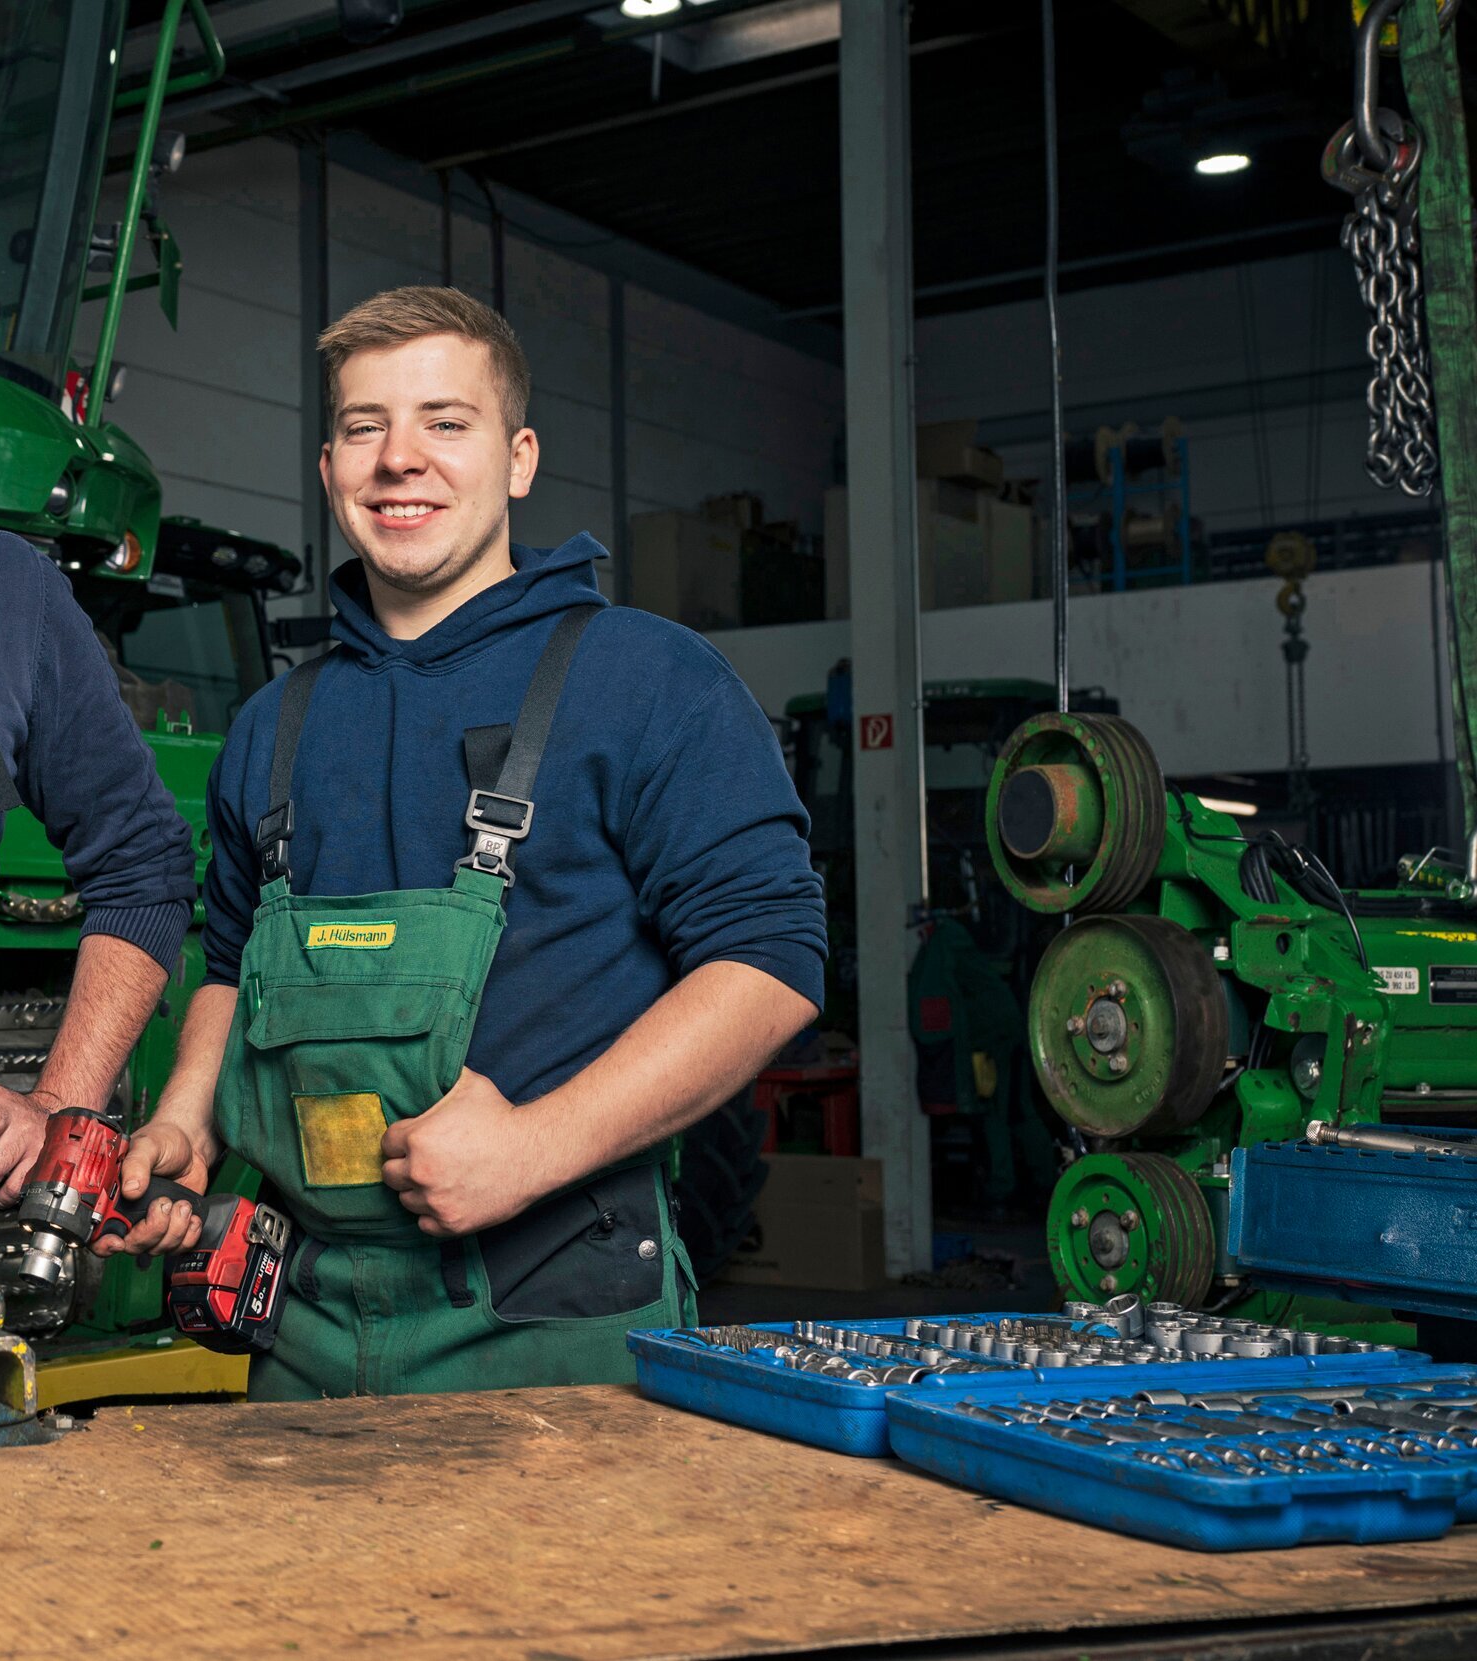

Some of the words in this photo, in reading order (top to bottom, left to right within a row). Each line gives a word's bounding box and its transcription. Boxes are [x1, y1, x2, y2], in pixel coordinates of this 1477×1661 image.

[317, 929, 326, 942] J.
[329, 928, 387, 942] Hülsmann
[1394, 970, 1404, 979] 450
[253, 1249, 270, 1295] REDLITHIU
